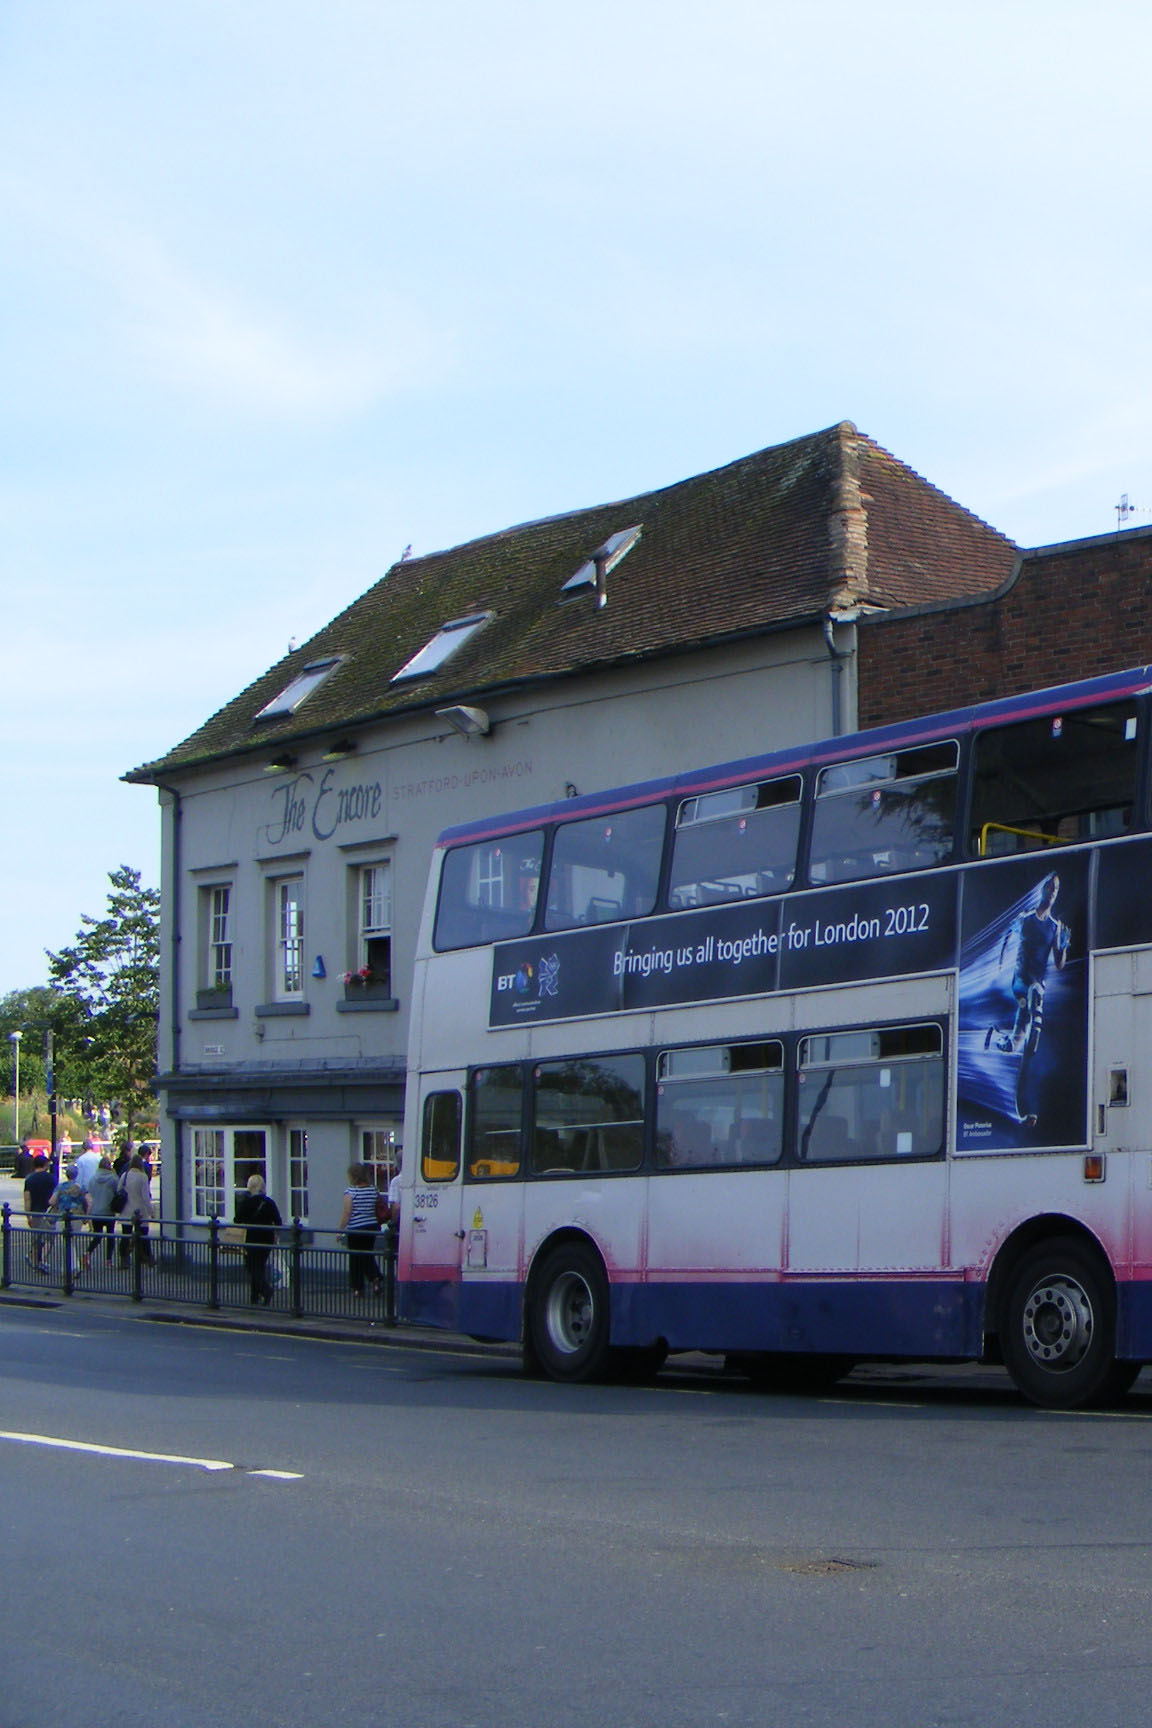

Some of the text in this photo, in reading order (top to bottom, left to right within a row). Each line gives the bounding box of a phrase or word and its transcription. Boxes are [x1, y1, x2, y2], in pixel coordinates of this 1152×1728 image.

[613, 902, 930, 977] Bringing us all together for London 2012
[497, 974, 517, 991] BT
[415, 1193, 439, 1208] 38126
